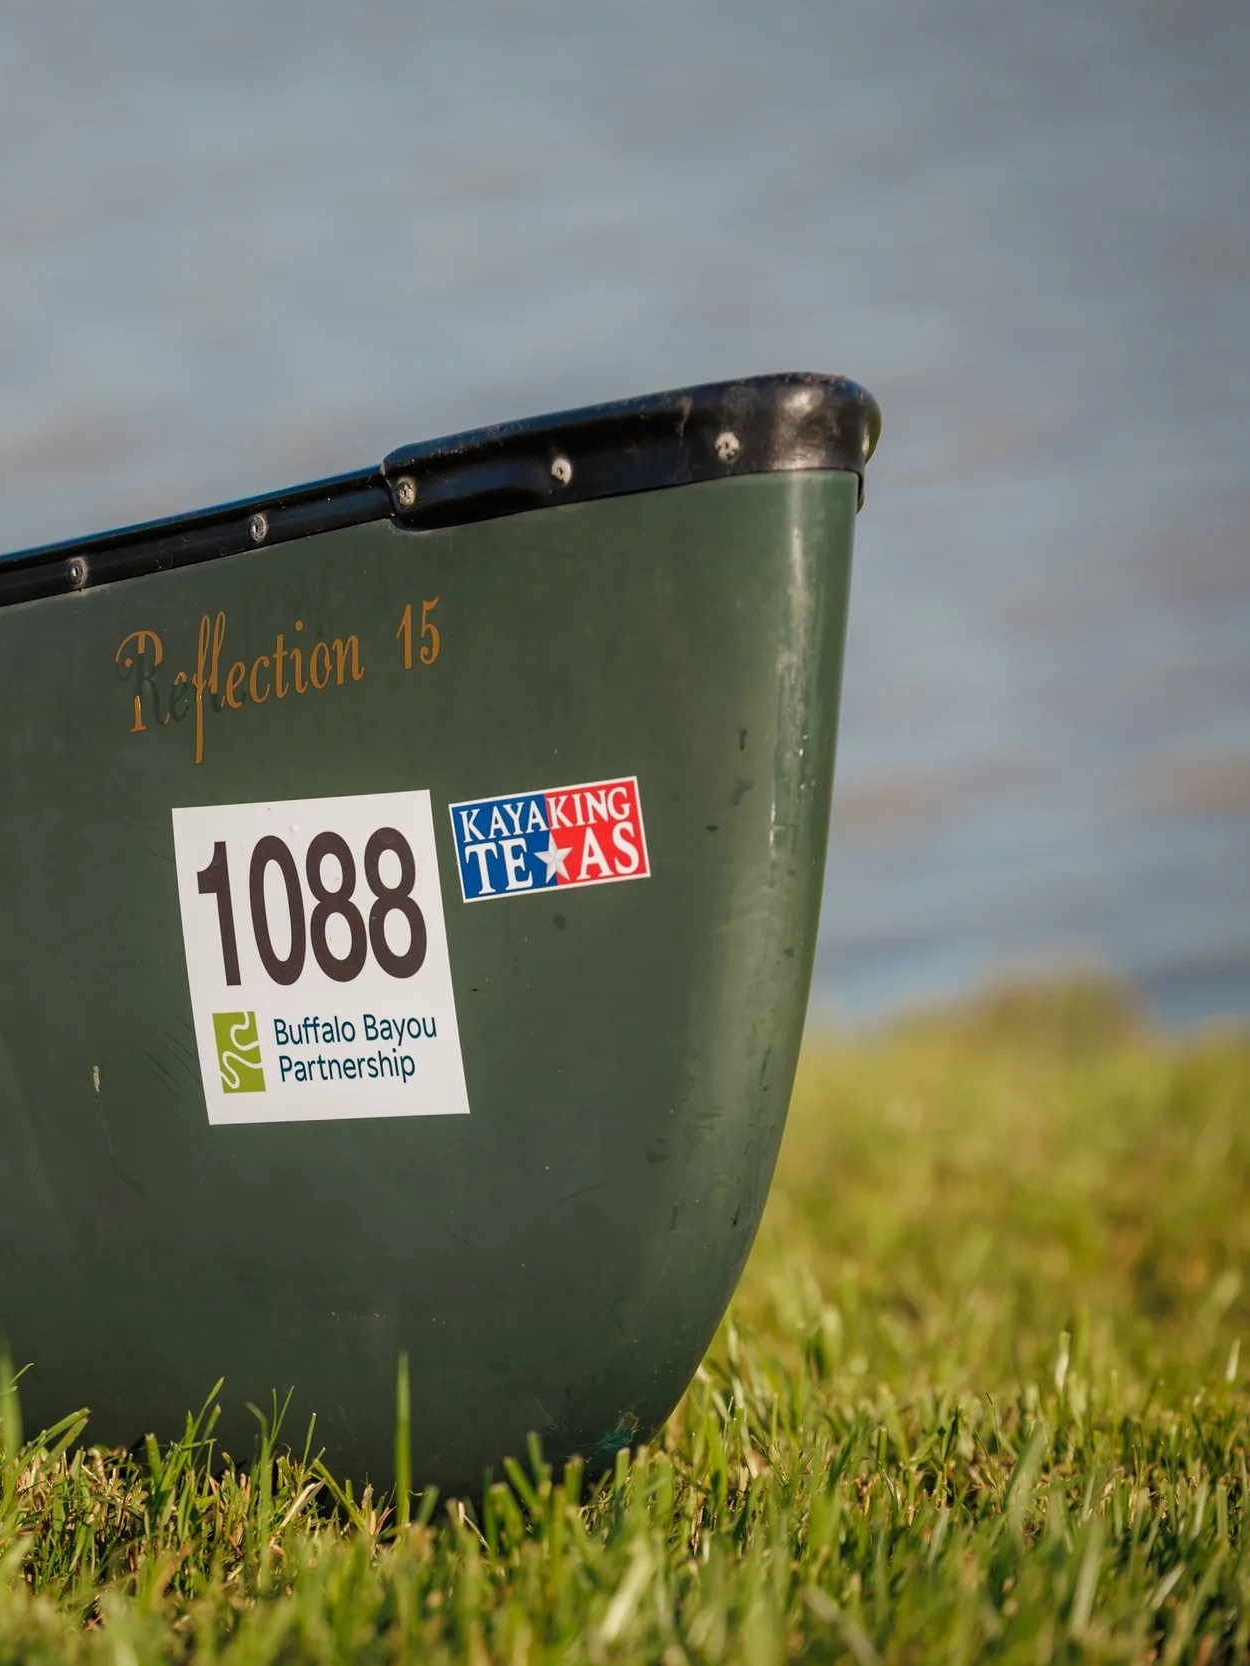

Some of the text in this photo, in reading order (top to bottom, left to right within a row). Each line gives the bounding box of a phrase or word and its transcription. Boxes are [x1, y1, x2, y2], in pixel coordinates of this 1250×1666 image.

[114, 596, 441, 765] Reflection 15
[458, 786, 632, 843] KAYAKING
[196, 826, 428, 987] 1088
[273, 1013, 438, 1047] Buffalo Bayou
[278, 1047, 416, 1084] Partnership
